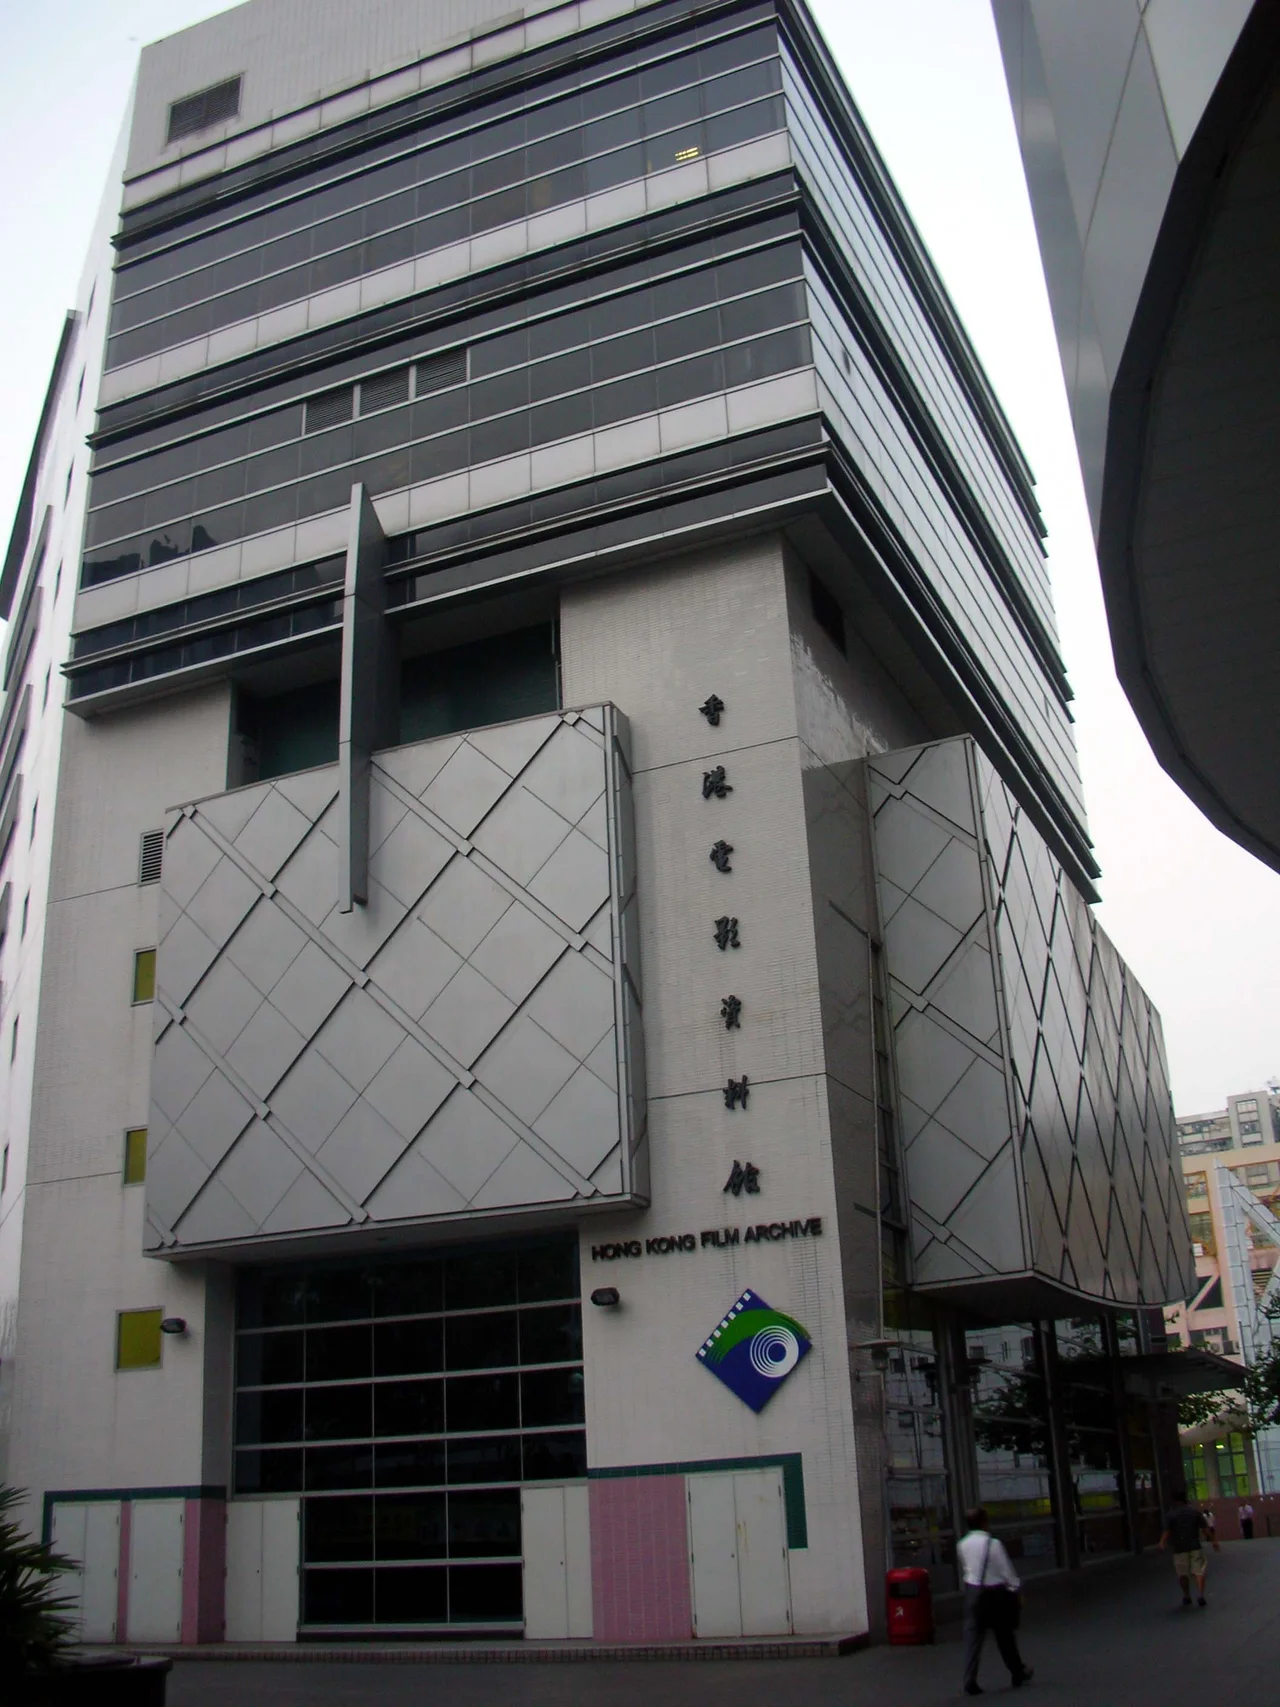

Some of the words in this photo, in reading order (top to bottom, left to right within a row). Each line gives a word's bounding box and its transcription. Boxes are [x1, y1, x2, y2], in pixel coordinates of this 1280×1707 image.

[592, 1240, 642, 1261] HONG
[646, 1234, 696, 1254] KONG
[701, 1226, 740, 1248] FILM
[744, 1217, 822, 1243] ARCHIVE
